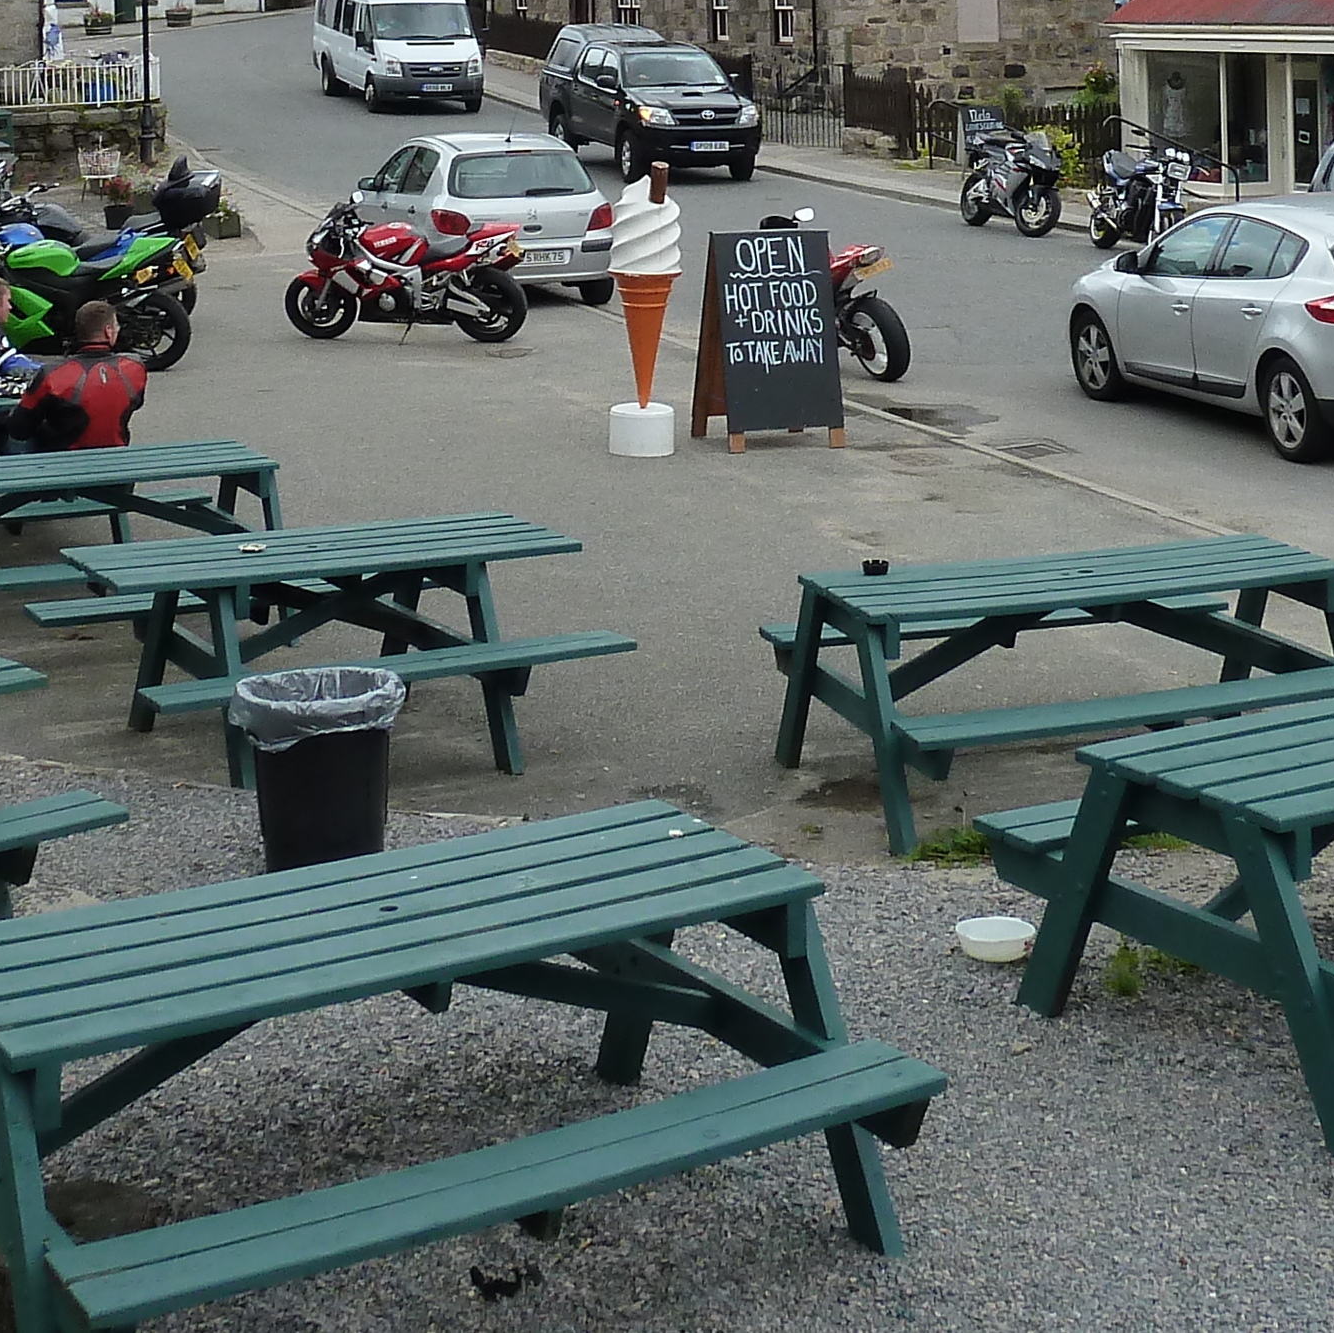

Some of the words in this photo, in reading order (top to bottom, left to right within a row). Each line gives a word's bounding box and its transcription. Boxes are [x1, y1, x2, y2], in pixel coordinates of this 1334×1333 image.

[735, 236, 806, 275] OPEN
[724, 282, 763, 316] HOT
[769, 279, 818, 308] FOOD
[751, 308, 824, 337] DRINKS
